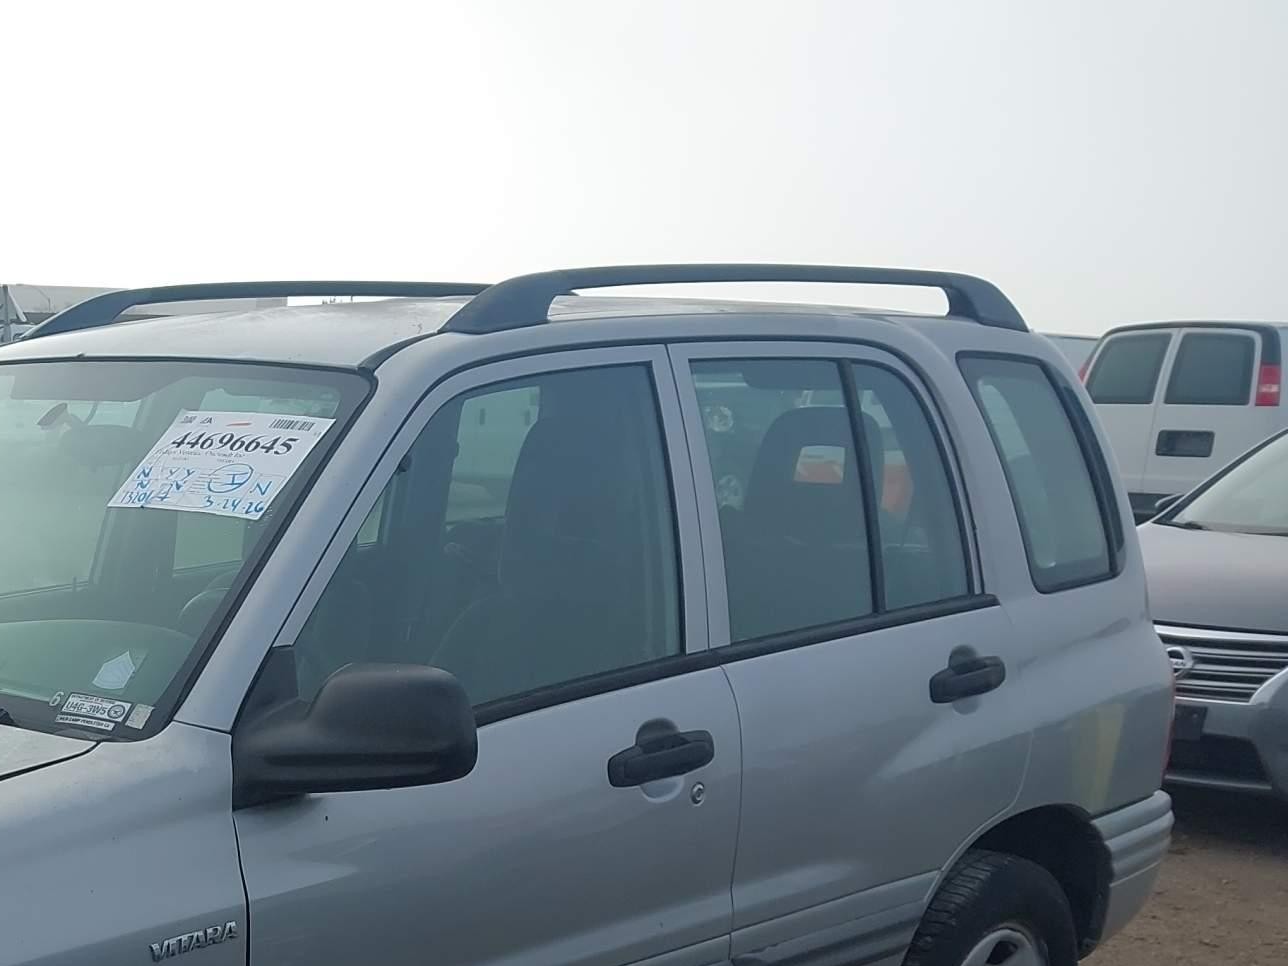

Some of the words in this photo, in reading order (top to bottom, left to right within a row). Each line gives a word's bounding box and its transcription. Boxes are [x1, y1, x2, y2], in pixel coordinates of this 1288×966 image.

[172, 431, 299, 455] 44696645
[254, 481, 272, 496] N
[49, 691, 65, 707] 6
[149, 921, 238, 962] VITARA
